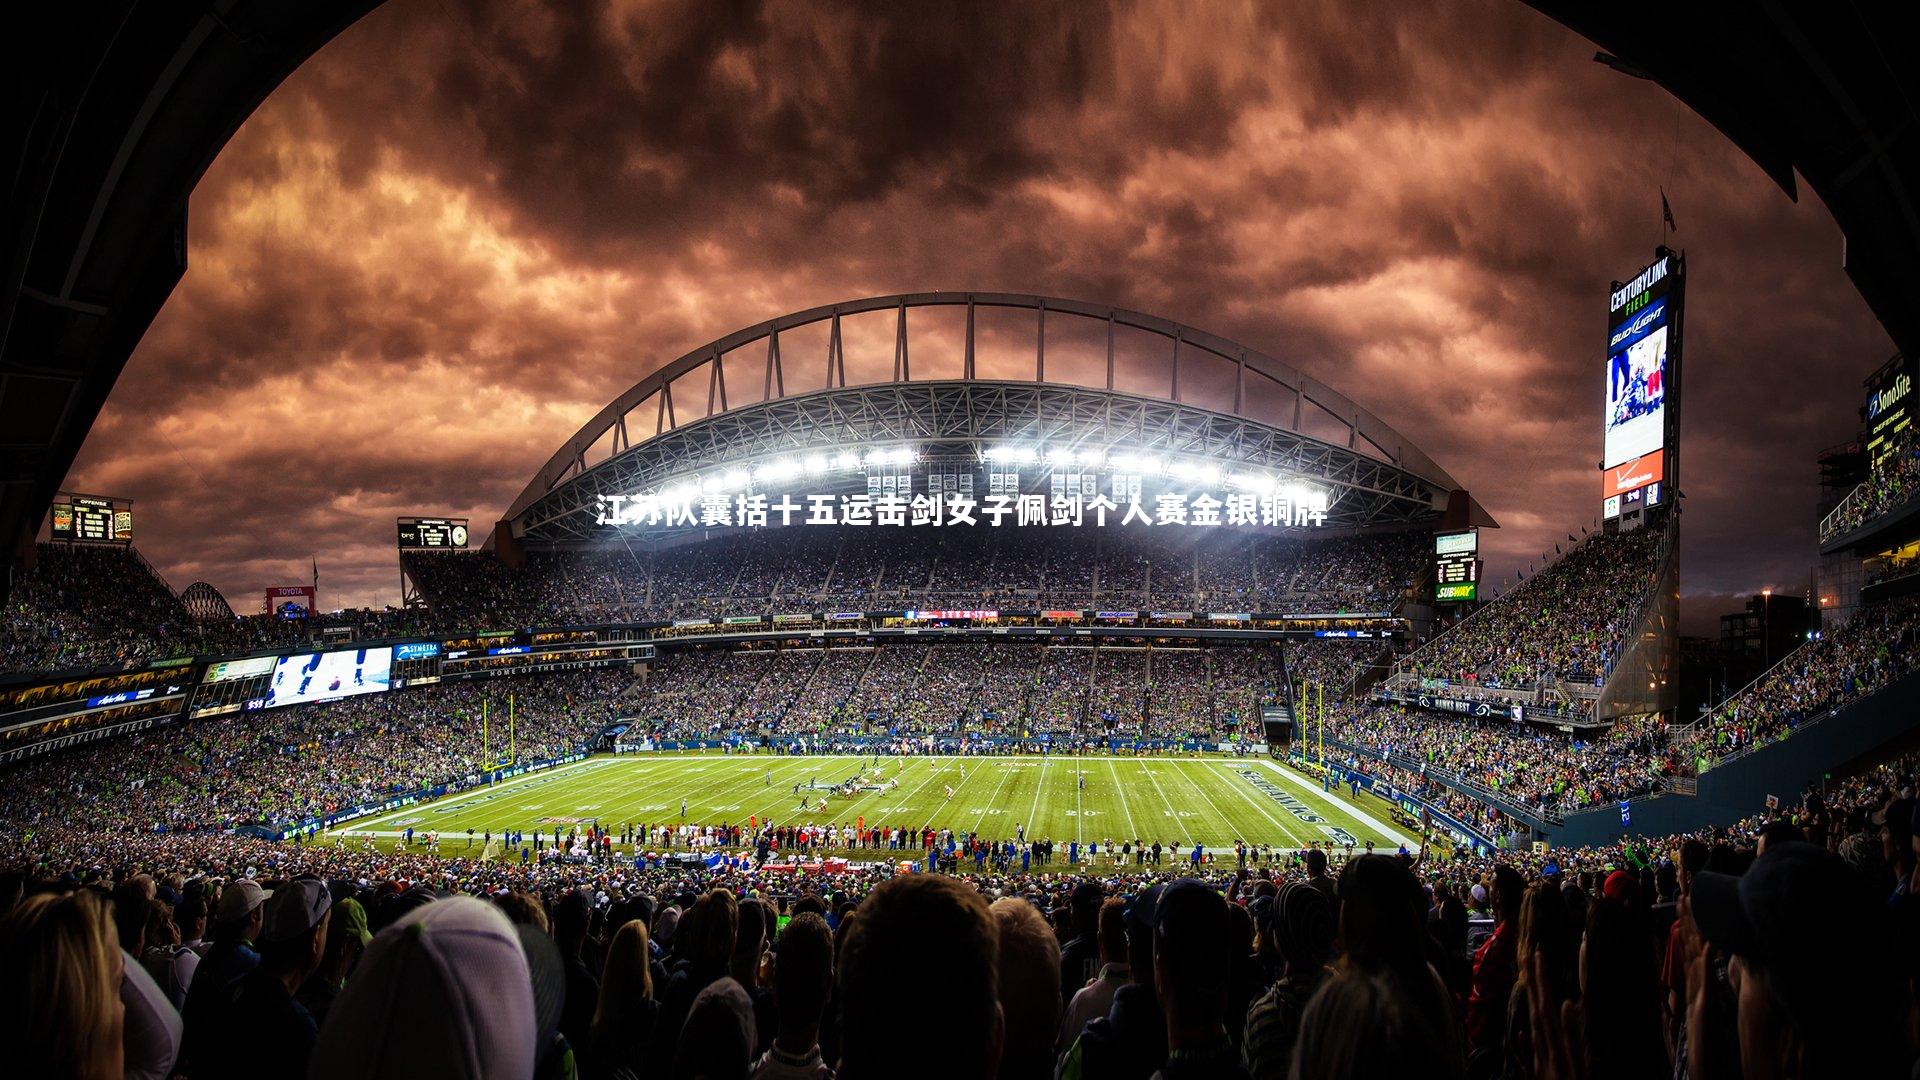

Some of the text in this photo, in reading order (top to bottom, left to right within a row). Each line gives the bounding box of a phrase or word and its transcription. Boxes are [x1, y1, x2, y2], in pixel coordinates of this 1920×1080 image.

[1611, 256, 1668, 312] CENTURYLINK
[1625, 290, 1650, 316] FIELD
[1611, 306, 1664, 346] BUD LIGHT
[1878, 374, 1911, 413] SonoSite
[80, 499, 107, 507] OFFENSE
[401, 532, 414, 540] bing
[279, 588, 303, 596] TOYOTA
[1437, 585, 1475, 598] SUBWAY
[410, 644, 438, 652] SYMETRA
[490, 669, 516, 677] HOME
[9, 720, 153, 762] TO CENTURYLINK FIELD
[1233, 769, 1329, 823] SEAHAWKS
[1620, 806, 1630, 822] 12
